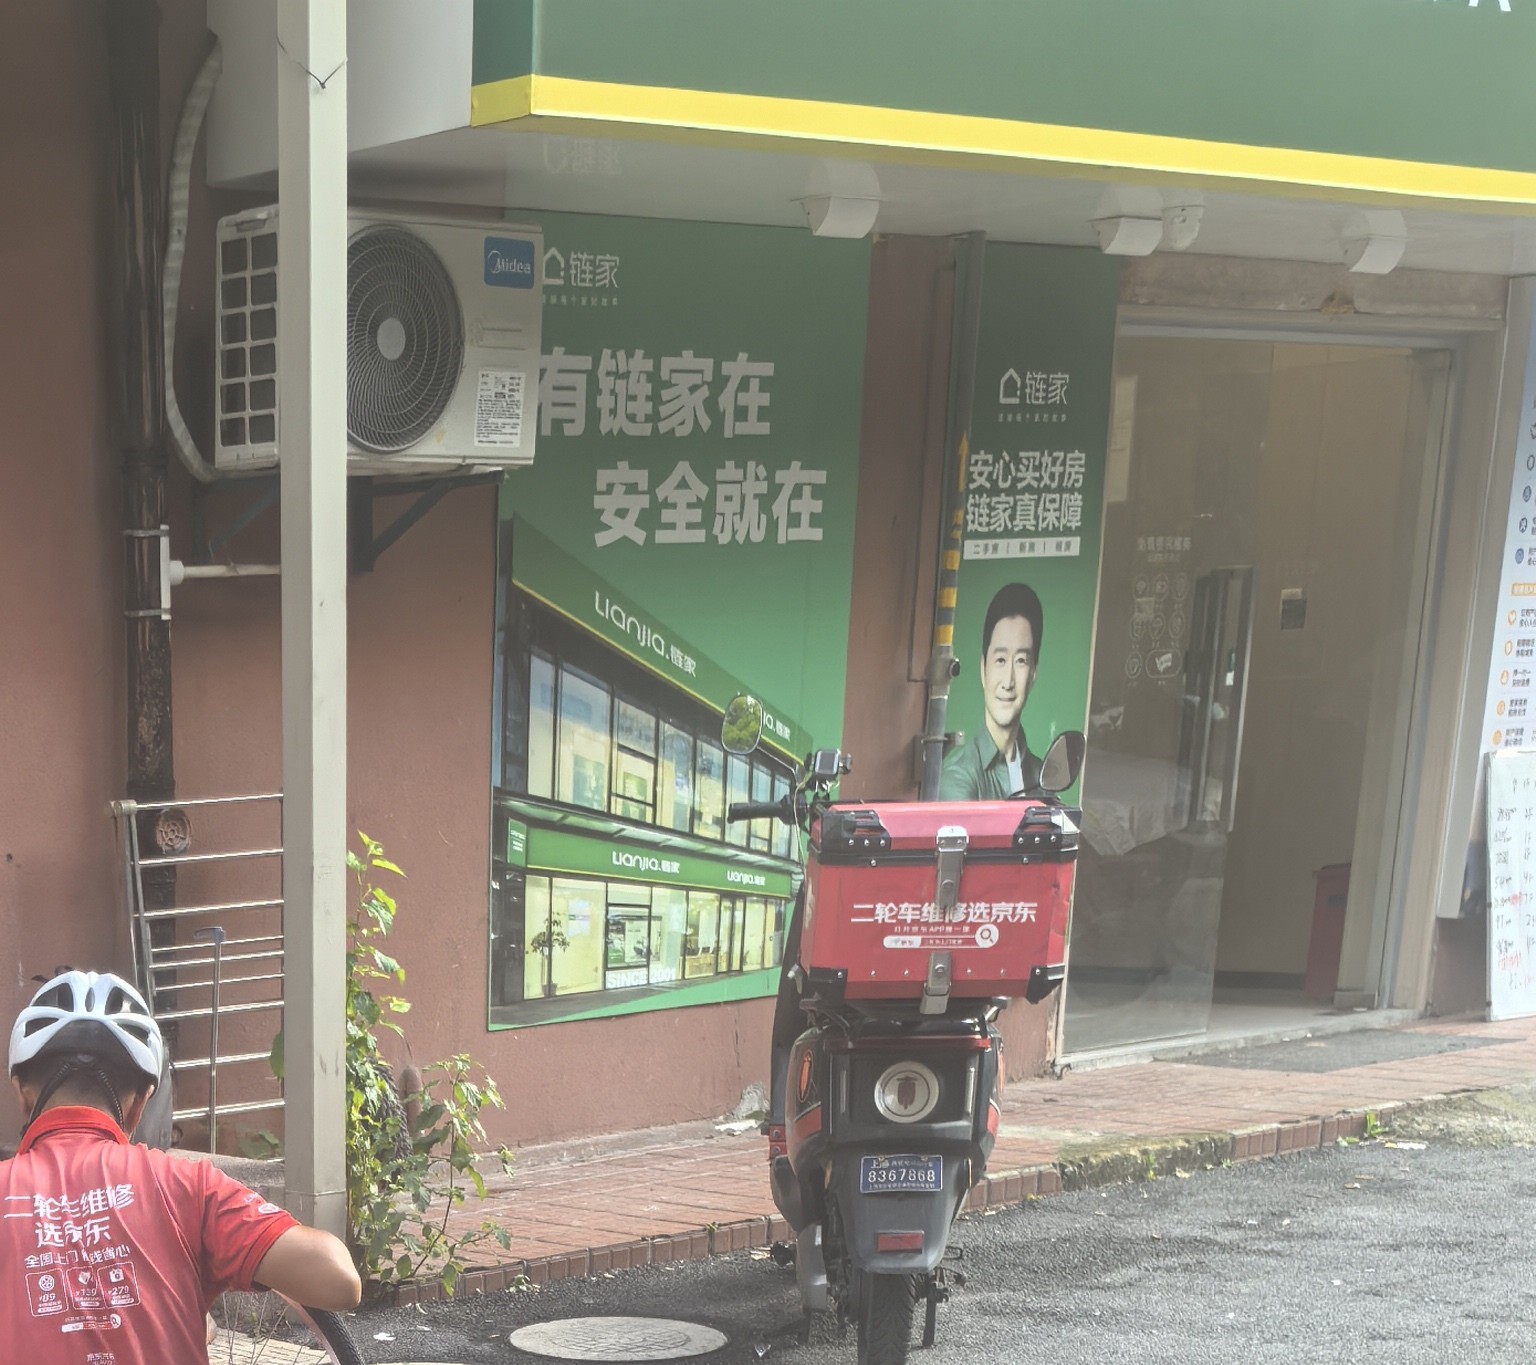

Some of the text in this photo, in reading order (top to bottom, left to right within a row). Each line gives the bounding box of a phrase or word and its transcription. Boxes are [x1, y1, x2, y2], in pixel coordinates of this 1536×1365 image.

[491, 254, 531, 274] Midea
[570, 251, 620, 288] 链家
[538, 346, 775, 438] 有链家在
[1025, 371, 1069, 405] 链家
[969, 450, 1086, 490] 安心买好房
[594, 460, 827, 548] 安全就在
[966, 492, 1083, 533] 链家真保障
[851, 902, 1039, 924] 二轮车维修选京东
[868, 1168, 936, 1183] 8367868
[3, 1183, 135, 1220] 二轮车维修
[34, 1216, 111, 1248] 选京东
[24, 1250, 78, 1268] 全国上门
